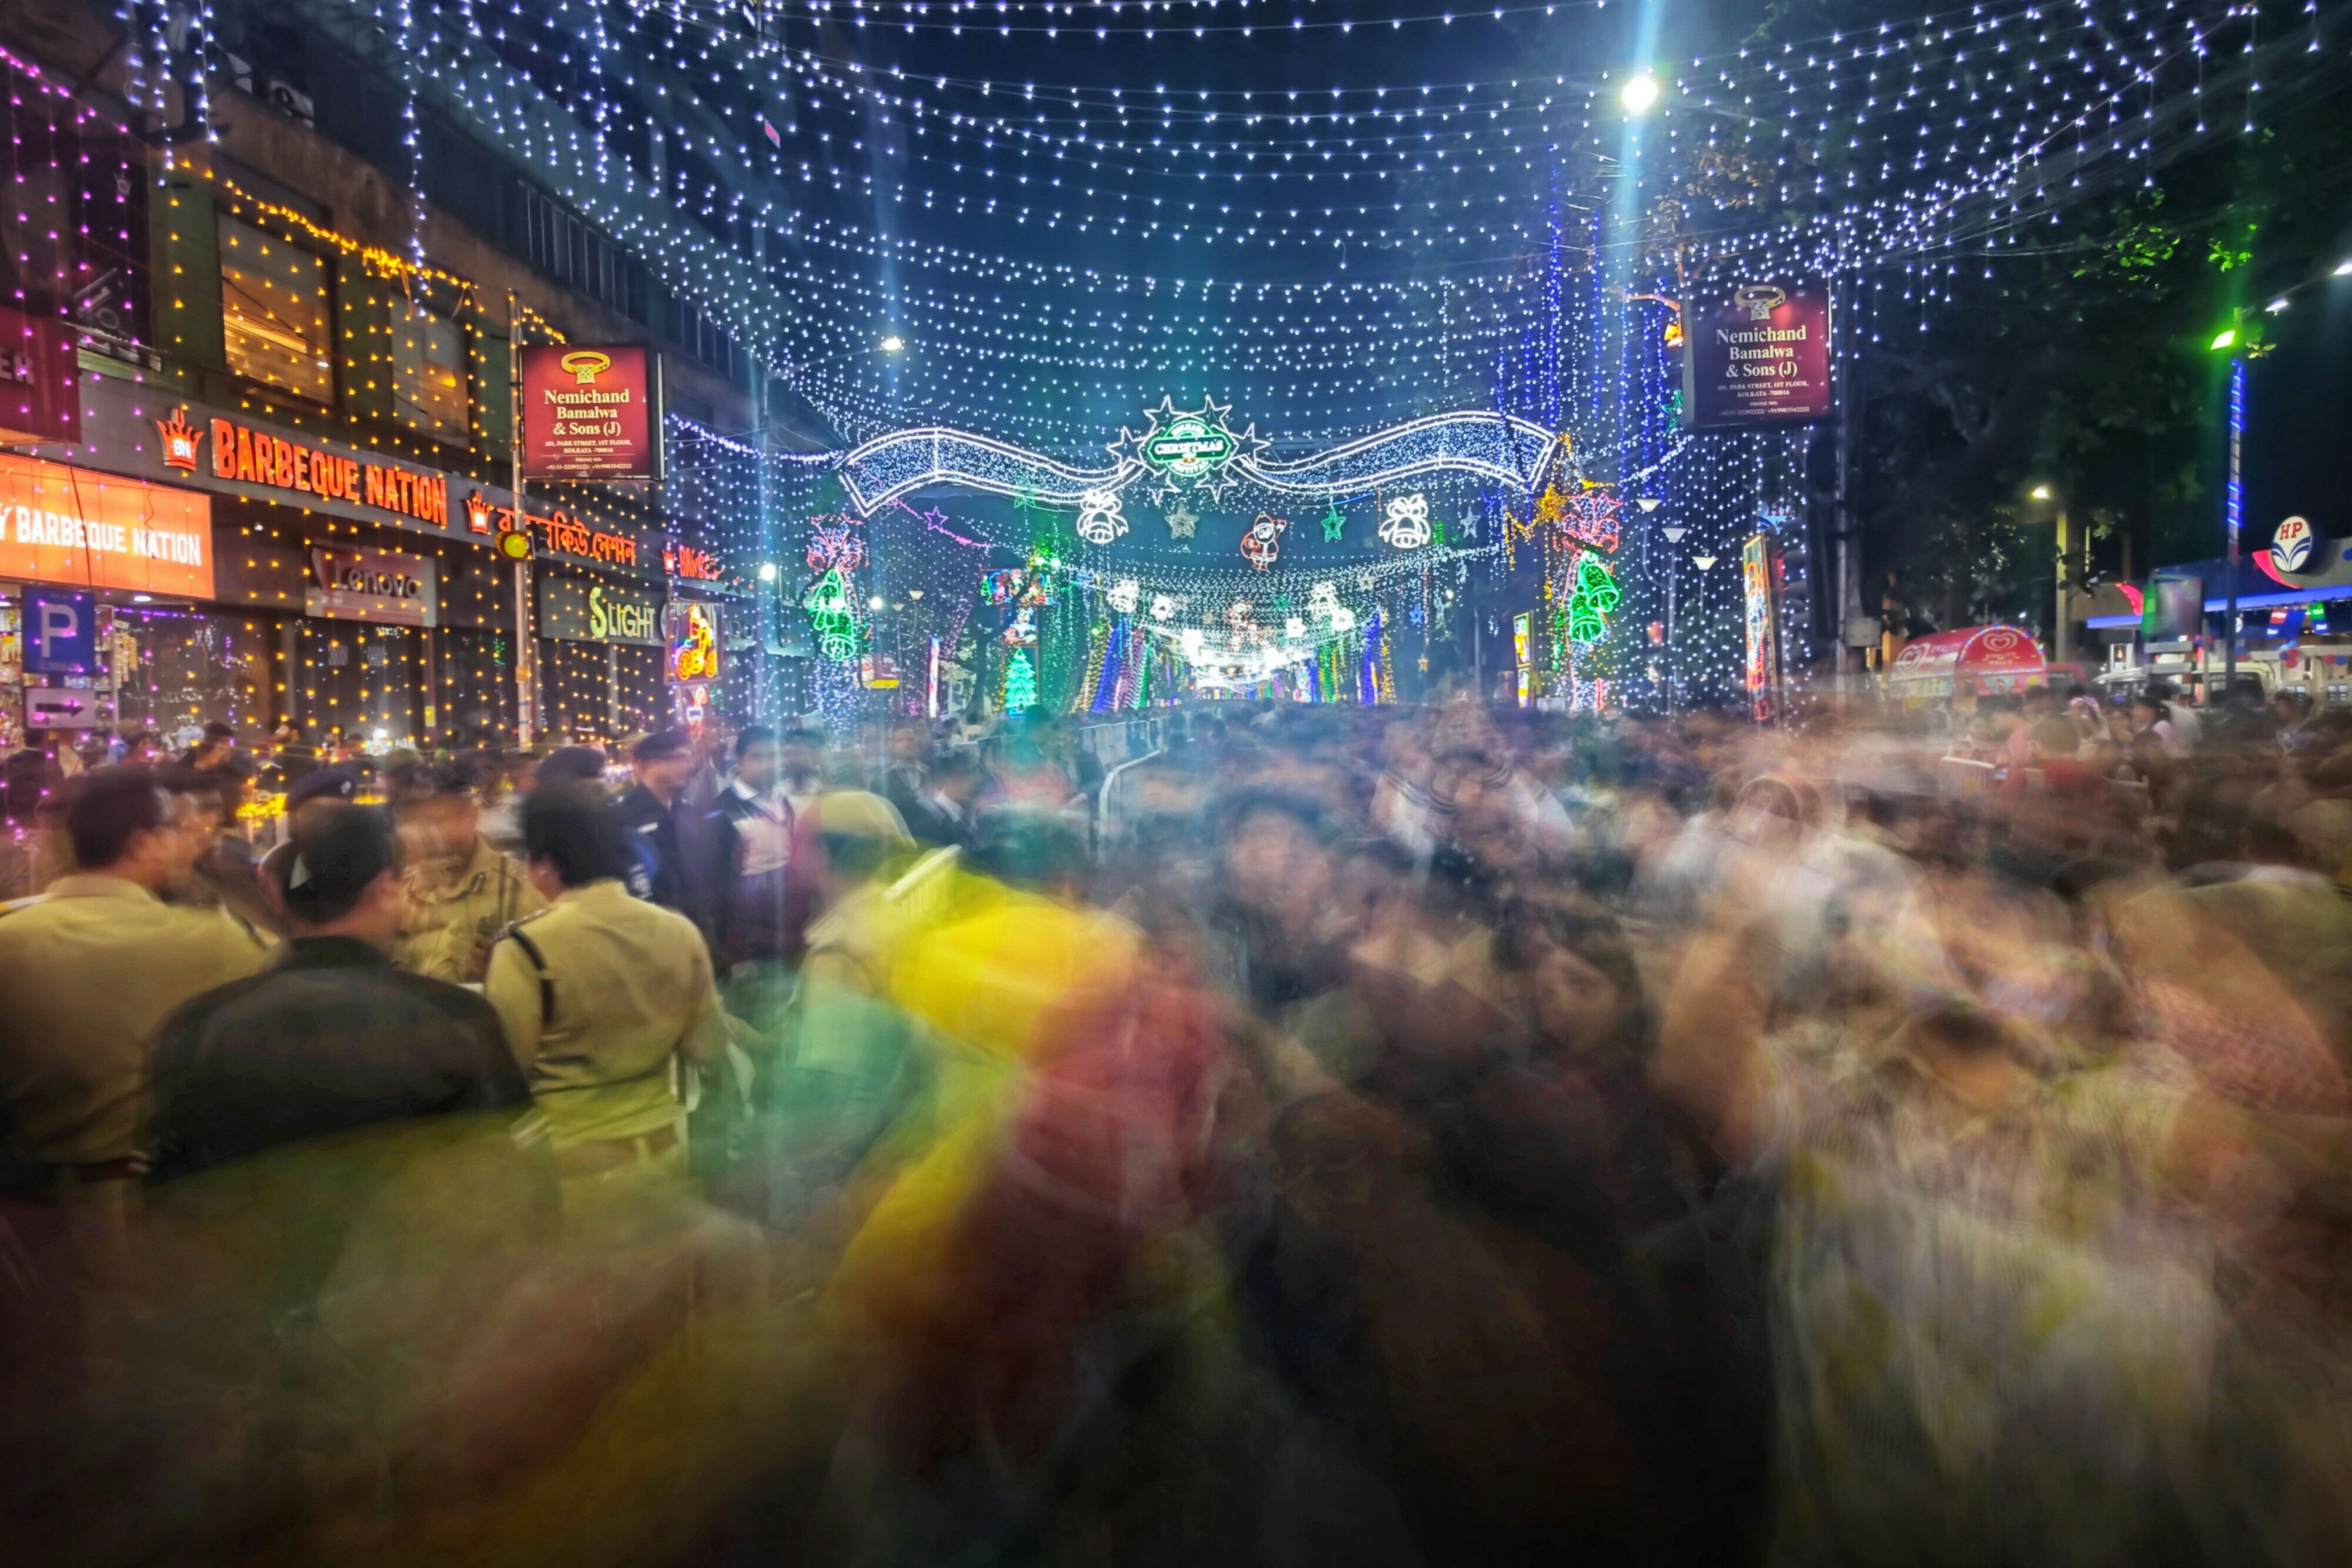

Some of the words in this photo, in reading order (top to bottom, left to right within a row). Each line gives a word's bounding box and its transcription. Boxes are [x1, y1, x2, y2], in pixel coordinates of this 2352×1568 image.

[1716, 325, 1806, 344] Nemichand
[1729, 345, 1794, 360] Bamalwa
[1726, 364, 1739, 378] &
[1743, 363, 1776, 376] Sons
[1778, 361, 1798, 378] (J)
[544, 389, 630, 404] Nemichand
[556, 406, 618, 419] Bamalwa
[553, 422, 566, 435] &
[569, 422, 600, 435] Sons
[603, 421, 621, 437] (J)
[173, 439, 192, 459] BN
[212, 419, 360, 500] BARBEQUE
[365, 464, 447, 526] NATION
[15, 506, 127, 553] BARBEQUE
[132, 527, 202, 567] NATION
[2279, 521, 2303, 541] HP
[335, 560, 421, 598] Lenovo
[589, 586, 656, 639] SLIGHT
[41, 603, 78, 658] P
